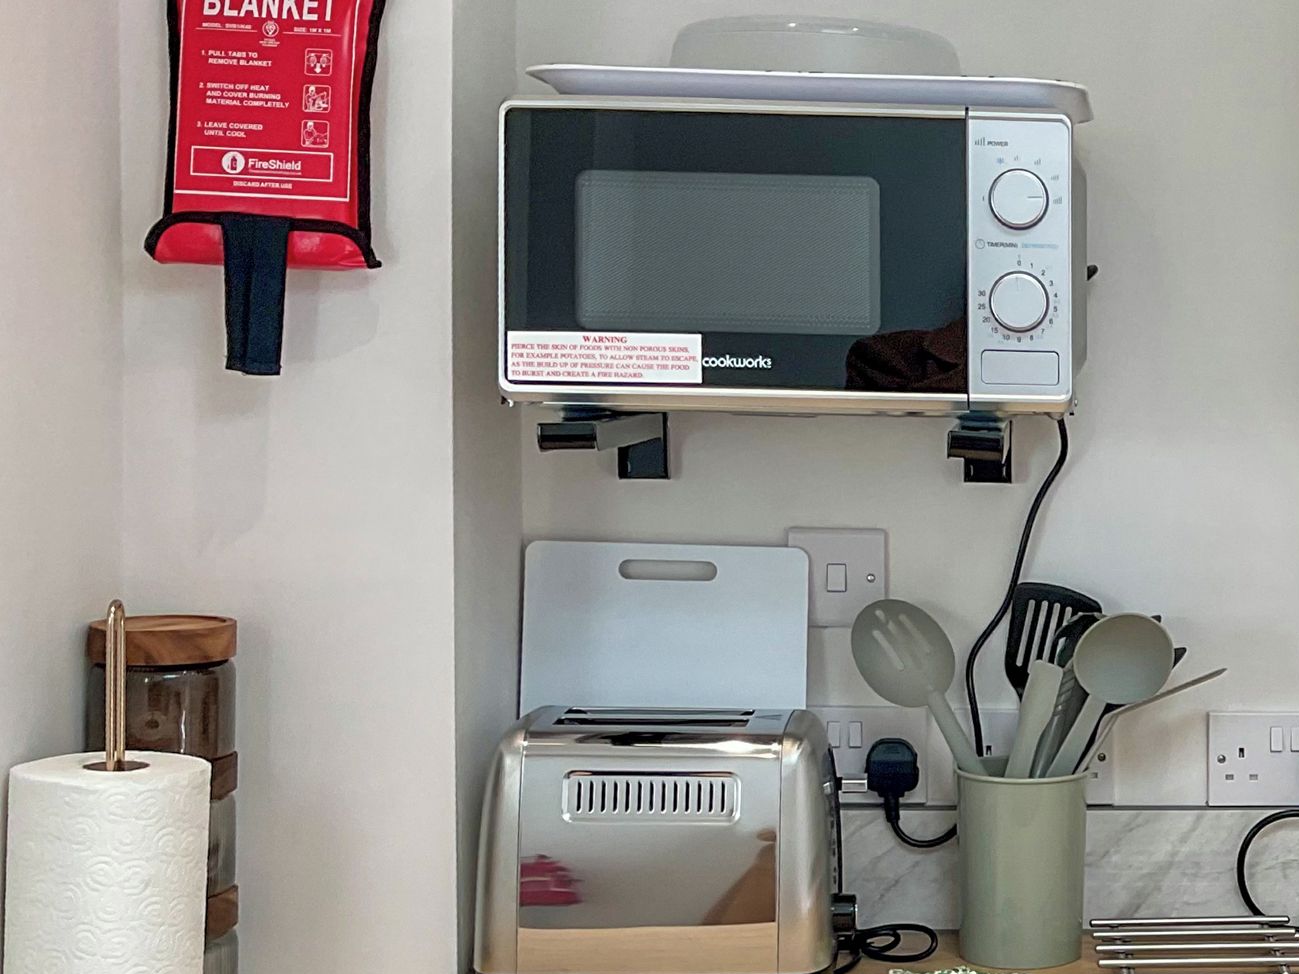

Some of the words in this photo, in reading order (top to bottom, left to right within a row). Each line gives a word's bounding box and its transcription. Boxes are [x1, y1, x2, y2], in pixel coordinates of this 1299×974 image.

[203, 0, 333, 21] BLANKET
[208, 57, 238, 65] REMOVE
[239, 59, 272, 67] BLANKET
[249, 92, 281, 100] BURNING
[206, 98, 241, 106] MATERIAL
[243, 100, 289, 108] COMPLETELY
[228, 122, 263, 130] COVERED
[226, 130, 246, 138] COOL
[248, 158, 301, 171] FireShield
[582, 335, 628, 344] WARNING
[702, 354, 772, 368] cookworks
